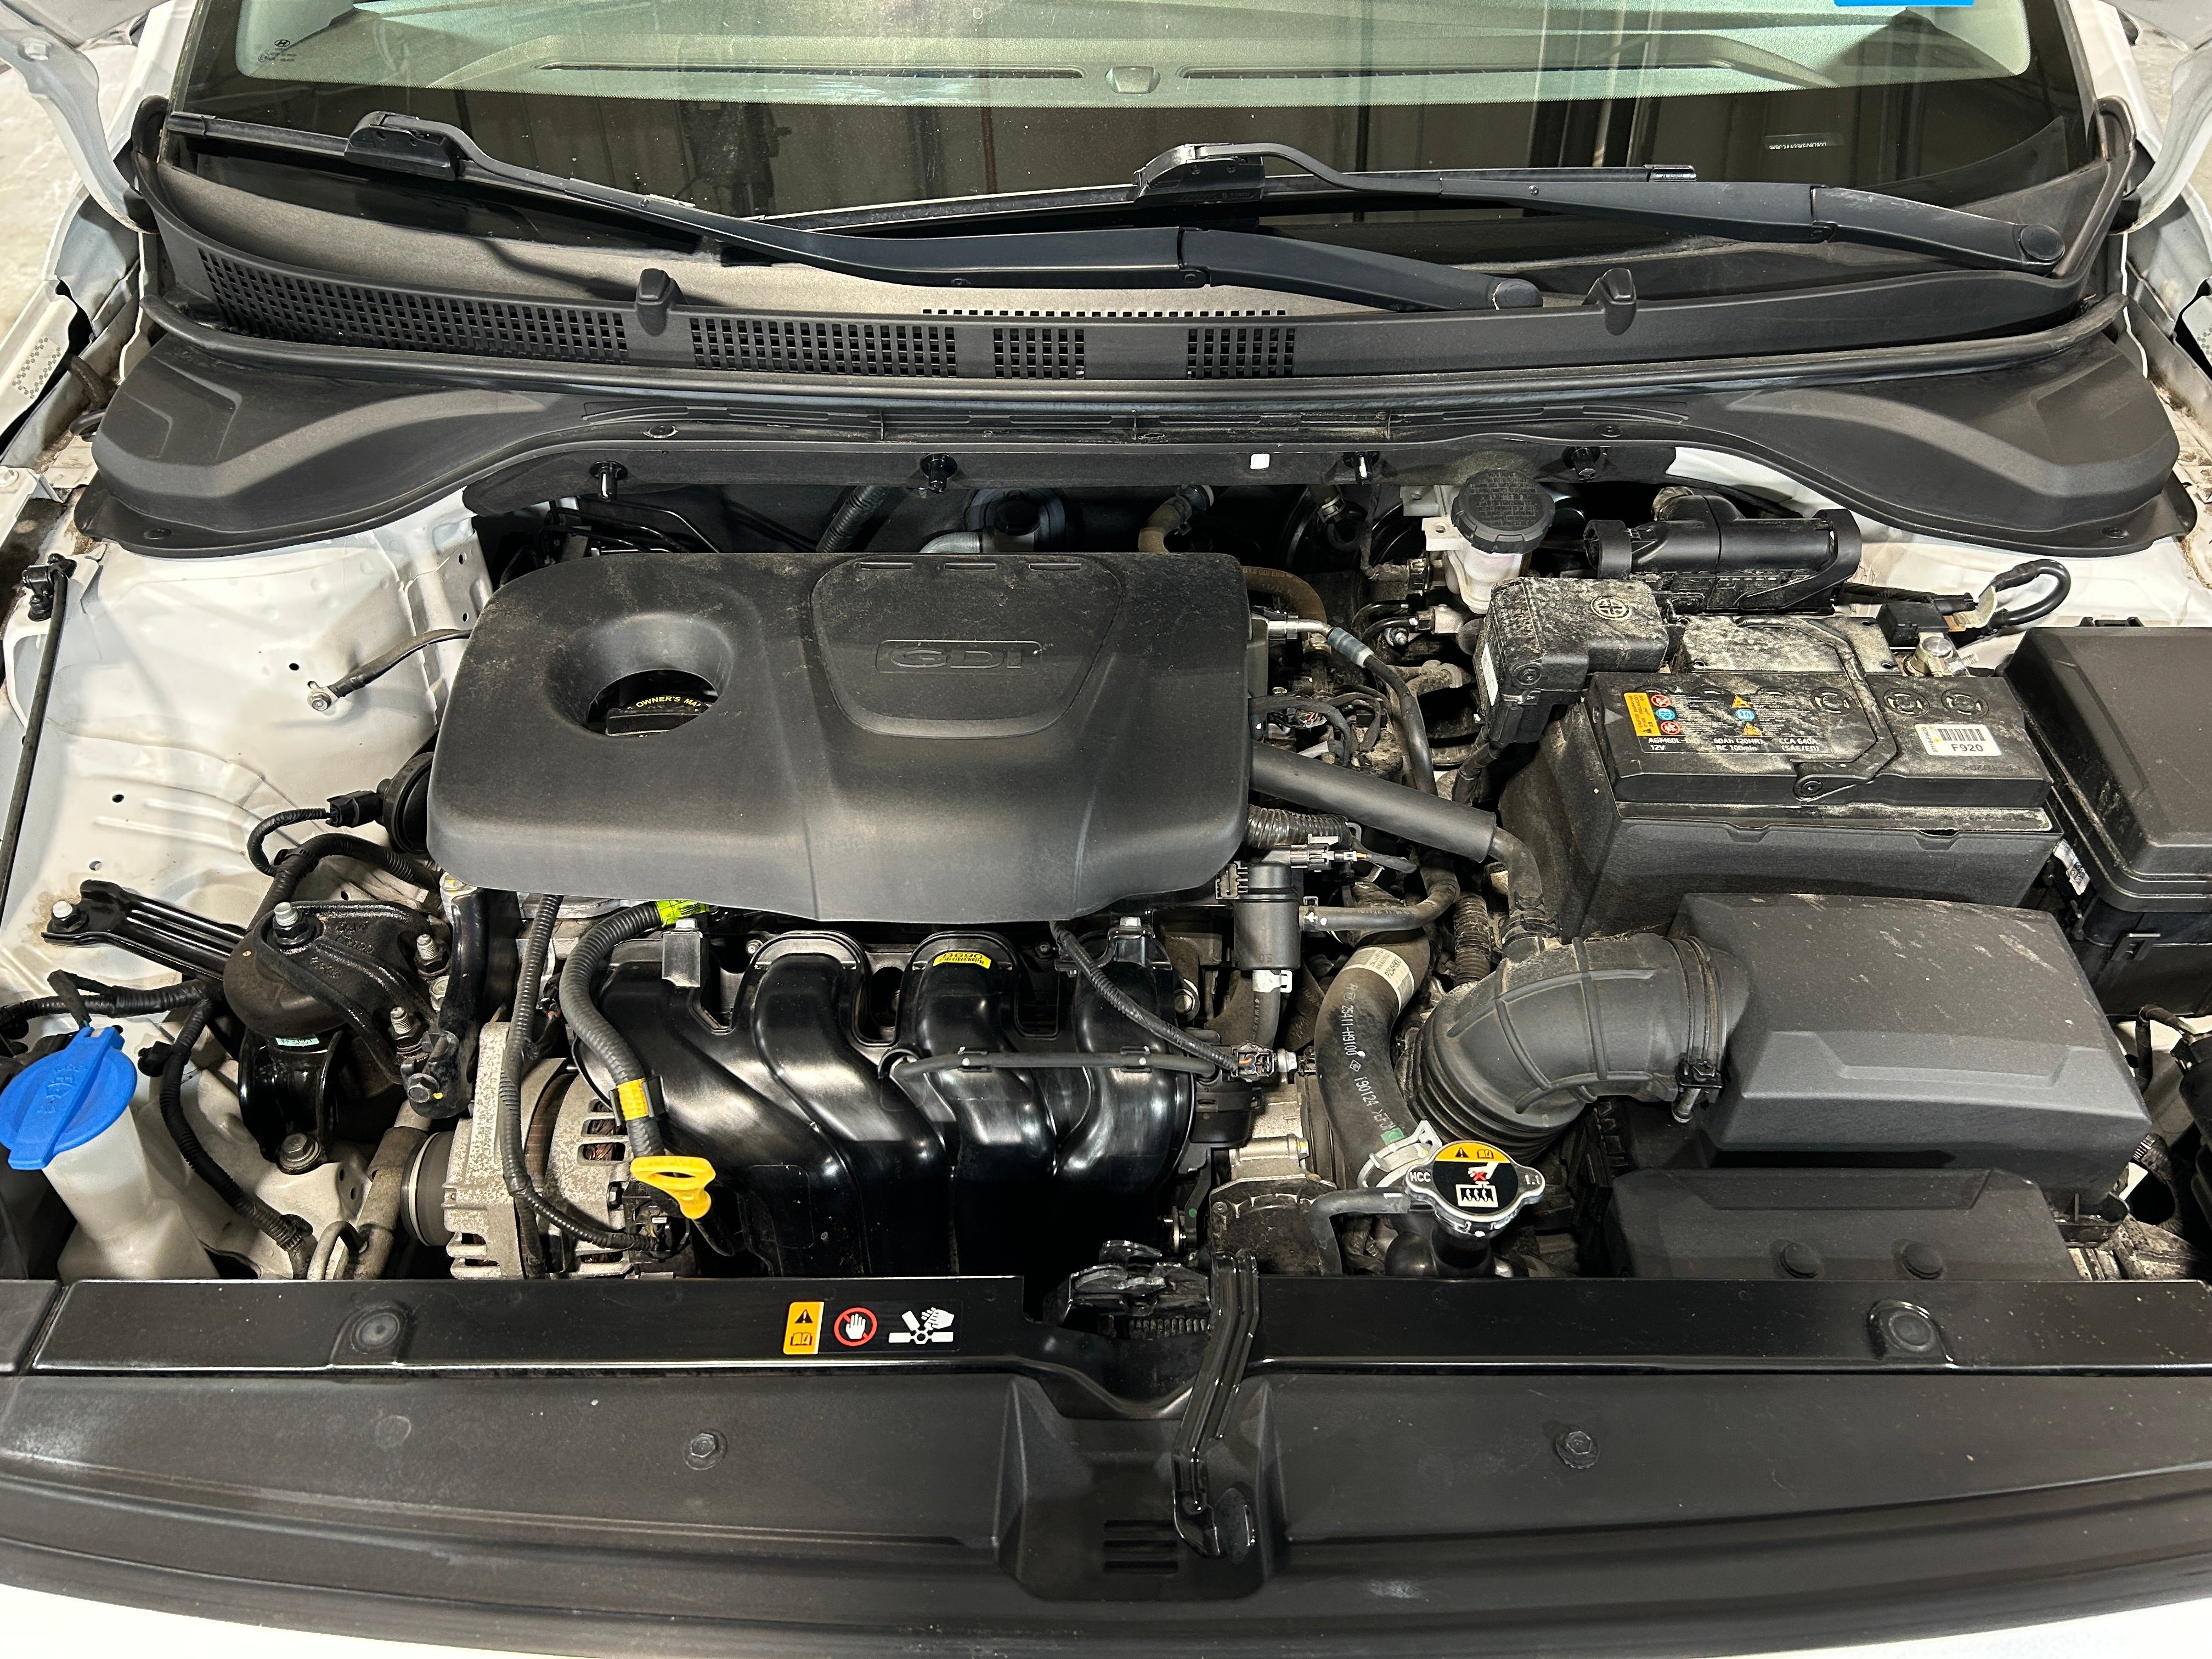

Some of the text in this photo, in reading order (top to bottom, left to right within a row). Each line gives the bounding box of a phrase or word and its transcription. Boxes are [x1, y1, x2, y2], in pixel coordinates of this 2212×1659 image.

[890, 647, 1023, 669] GDI
[636, 696, 681, 708] OWNER'S
[1341, 1005, 1358, 1056] 25411-H9100
[1354, 1076, 1379, 1107] 190124
[1410, 1171, 1431, 1182] HCC
[1525, 1174, 1541, 1185] 1.1
